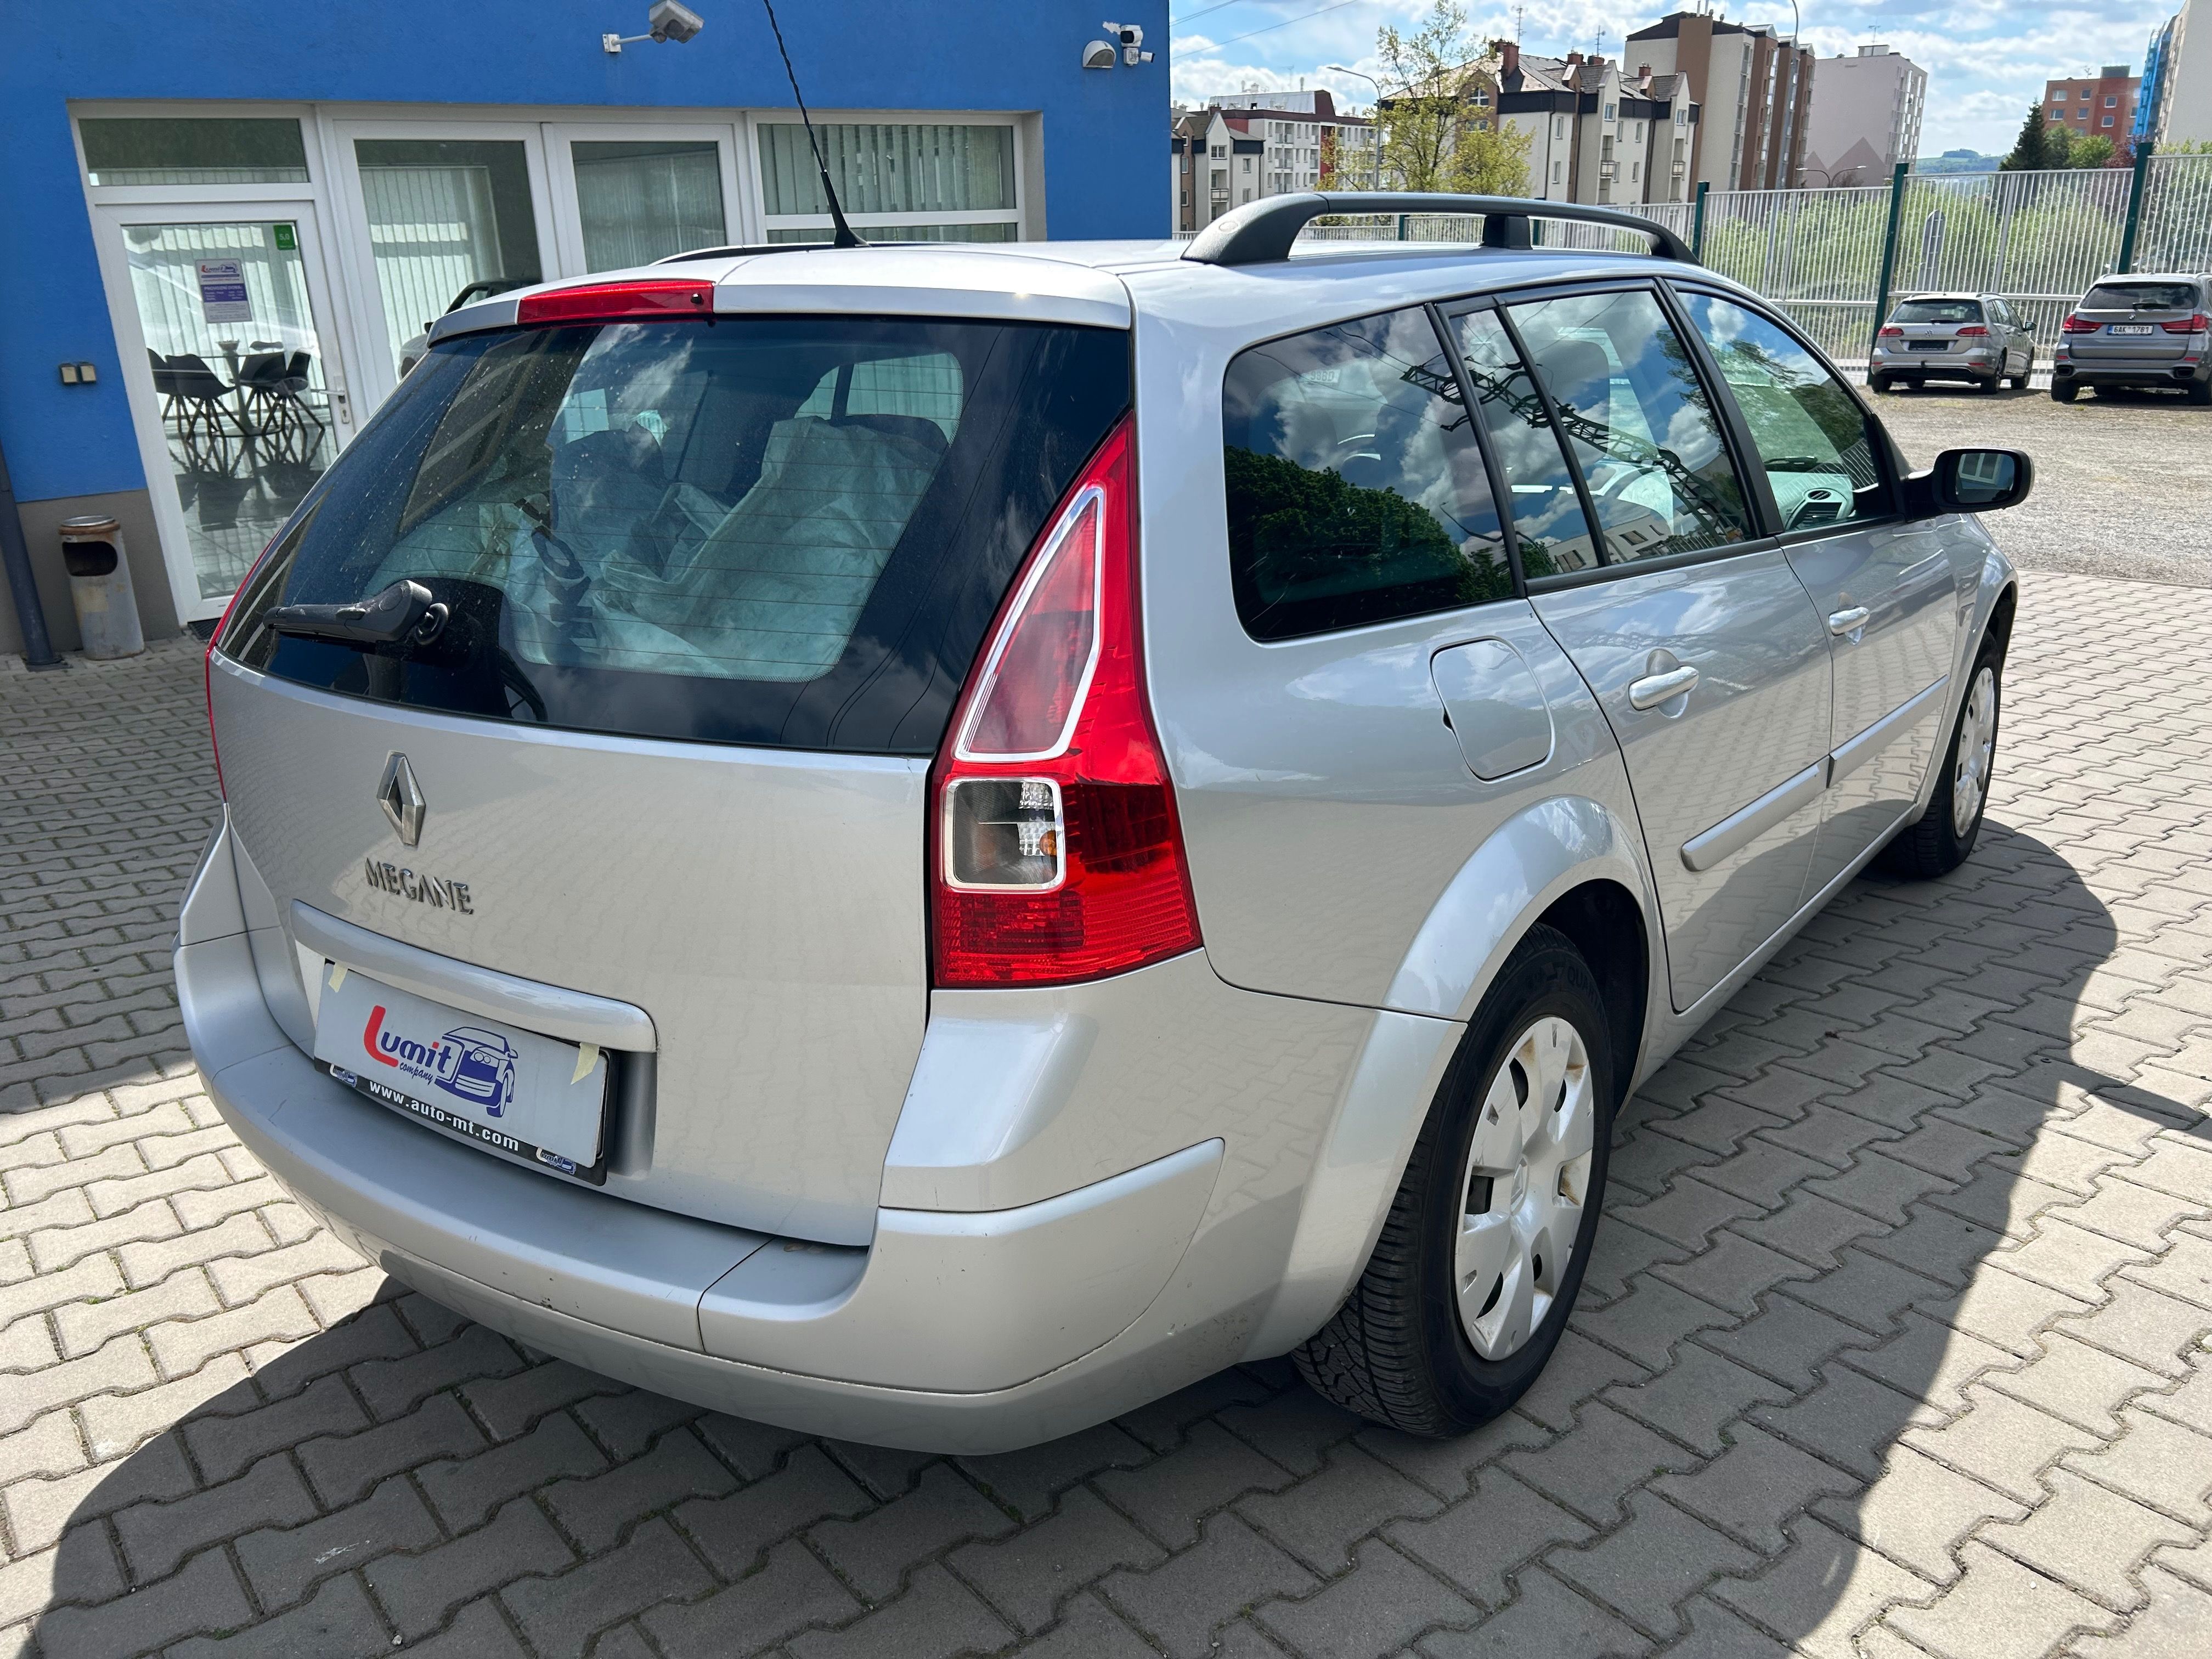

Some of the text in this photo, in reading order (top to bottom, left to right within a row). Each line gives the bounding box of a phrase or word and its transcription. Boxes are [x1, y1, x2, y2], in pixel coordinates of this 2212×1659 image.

[364, 857, 475, 915] MEGANE
[364, 1005, 452, 1074] Lumit
[399, 1061, 434, 1086] company
[369, 1080, 519, 1152] www.auto-mt.com
